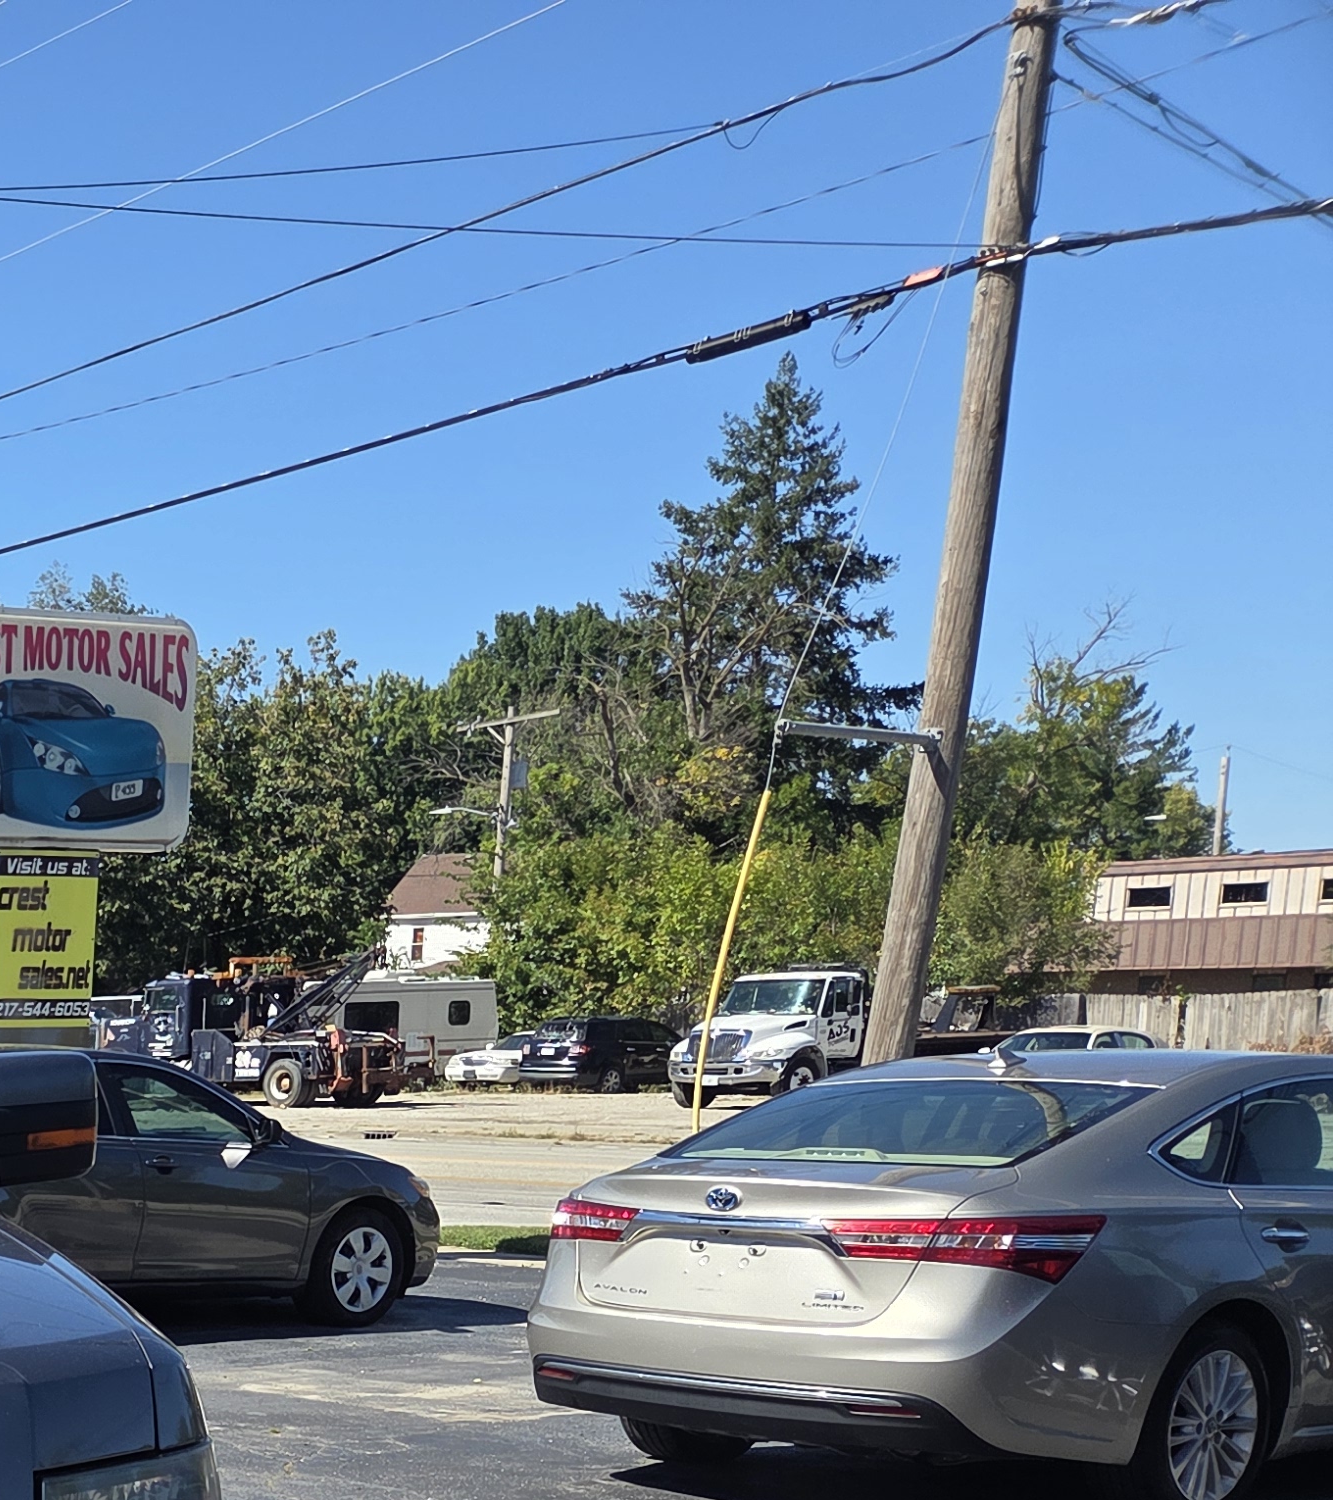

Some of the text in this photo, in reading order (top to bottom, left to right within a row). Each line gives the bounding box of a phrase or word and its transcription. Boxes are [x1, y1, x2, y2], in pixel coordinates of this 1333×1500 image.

[23, 625, 111, 677] MOTOR
[118, 631, 190, 712] SALES
[7, 857, 91, 876] Visit us at:
[11, 921, 72, 953] motor
[17, 959, 91, 990] sales.net
[593, 1283, 648, 1295] AVALON
